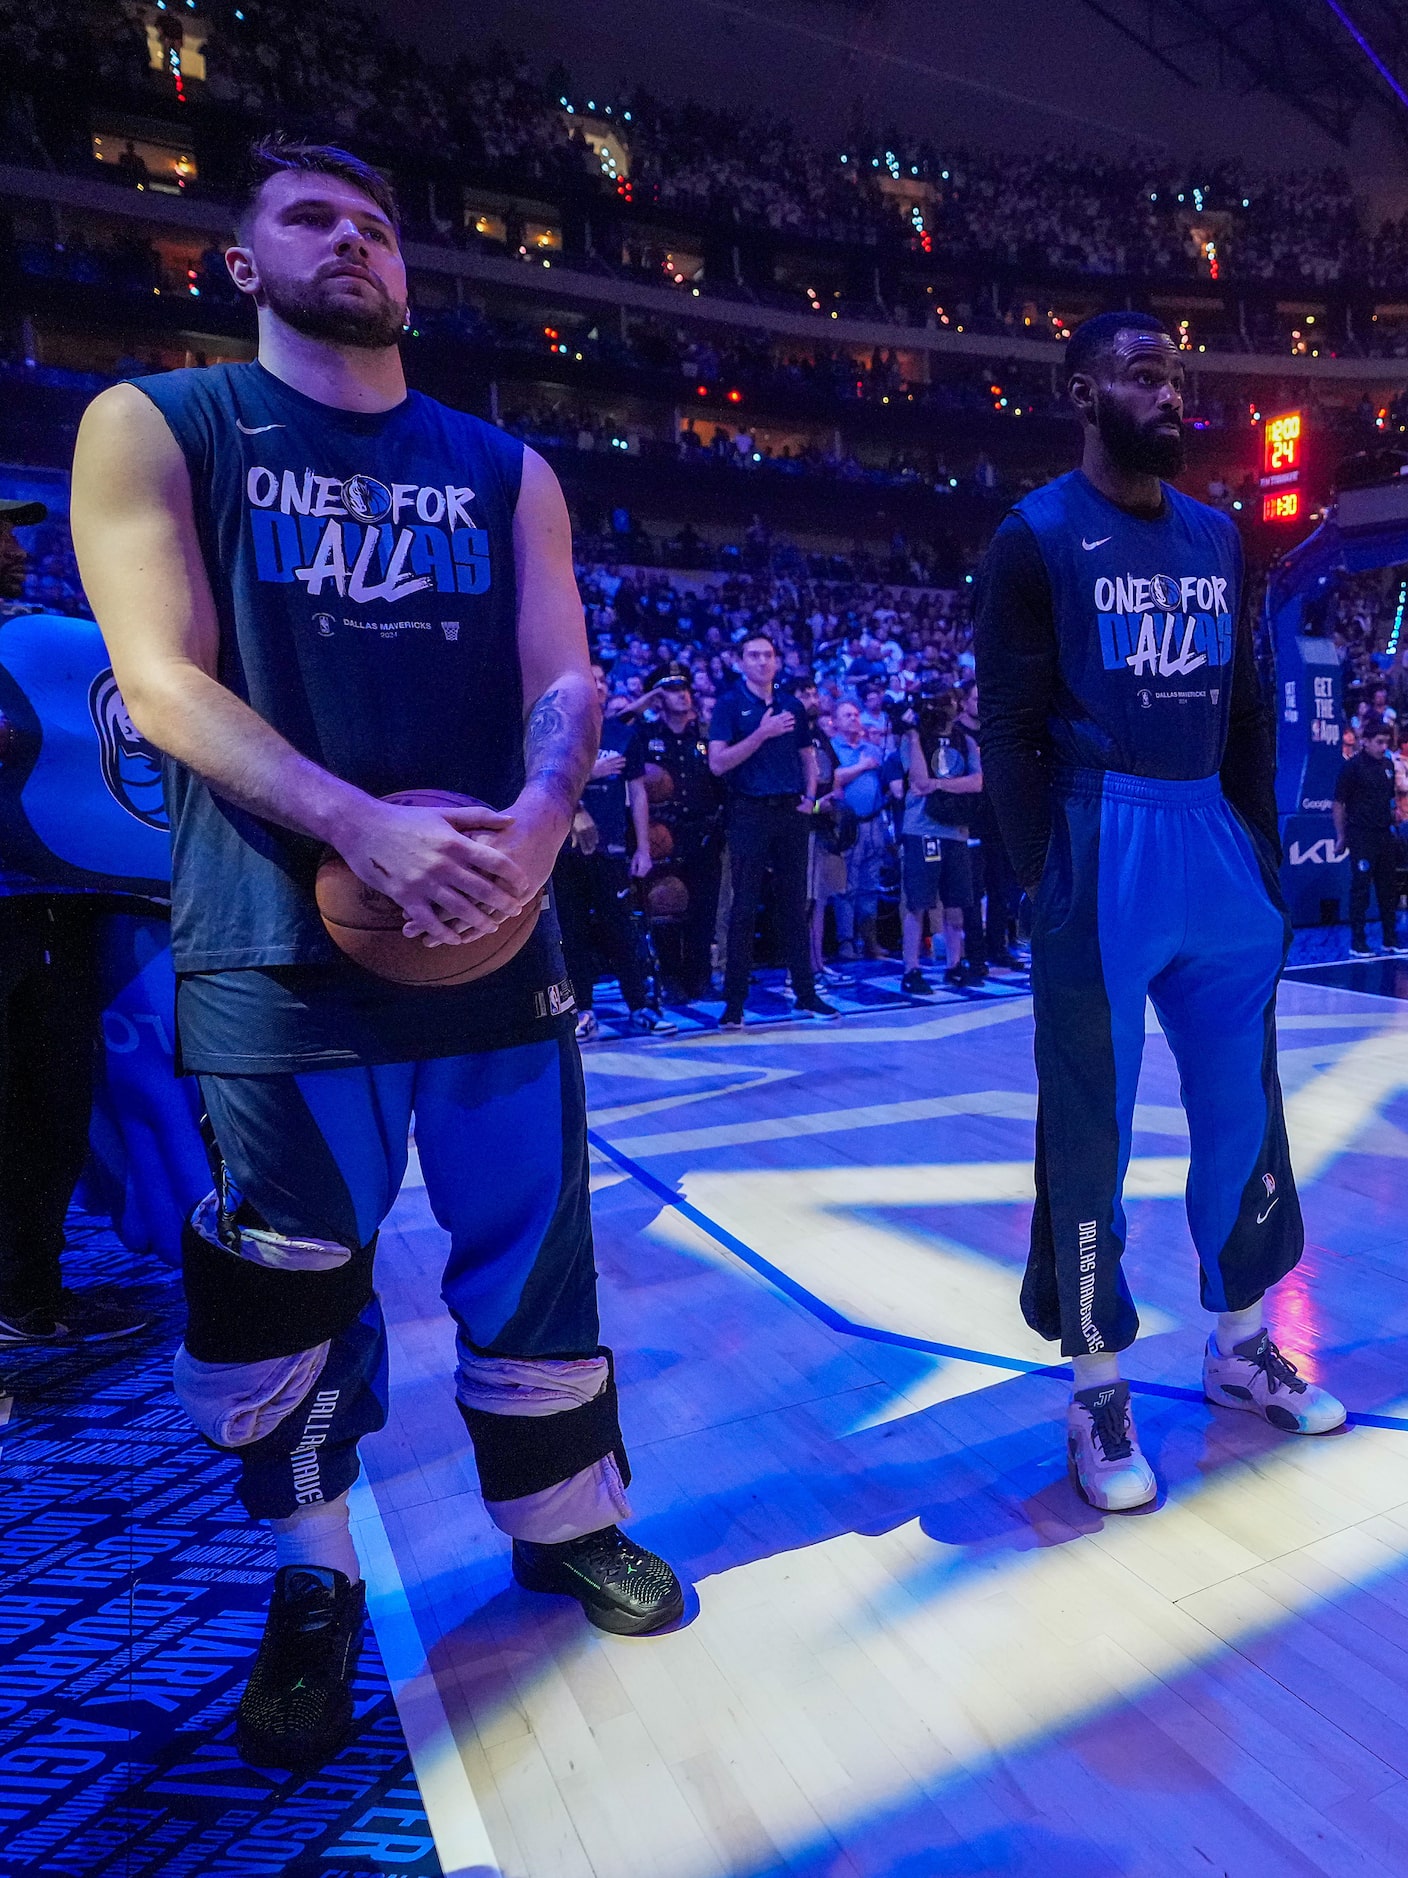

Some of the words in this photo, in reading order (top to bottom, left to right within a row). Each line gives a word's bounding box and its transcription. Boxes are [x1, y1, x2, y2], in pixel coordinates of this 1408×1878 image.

[1272, 440, 1294, 468] 24
[247, 466, 348, 518] ONE
[391, 482, 477, 534] FOR
[295, 518, 434, 603] ALL
[1094, 573, 1155, 615] ONE
[1180, 575, 1229, 617] FOR
[343, 618, 378, 630] DALLAS
[379, 621, 432, 631] MAVERICKS
[1126, 612, 1207, 677] ALL
[1078, 1219, 1097, 1273] DALLAS
[1079, 1272, 1105, 1354] MAVERICKS
[92, 1467, 188, 1502] MACK
[121, 1484, 203, 1518] FORTSON
[156, 1495, 233, 1525] BOOTH
[28, 1523, 199, 1588] JOSH
[169, 1544, 265, 1566] DAHNTAY
[171, 1567, 223, 1582] JAMES
[209, 1569, 275, 1584] JOHNSON
[142, 1616, 200, 1641] RYAN
[54, 1641, 160, 1701] BROEKHOFF
[80, 1609, 269, 1713] MARK
[38, 1806, 168, 1878] TERRY
[143, 1817, 198, 1843] JIM
